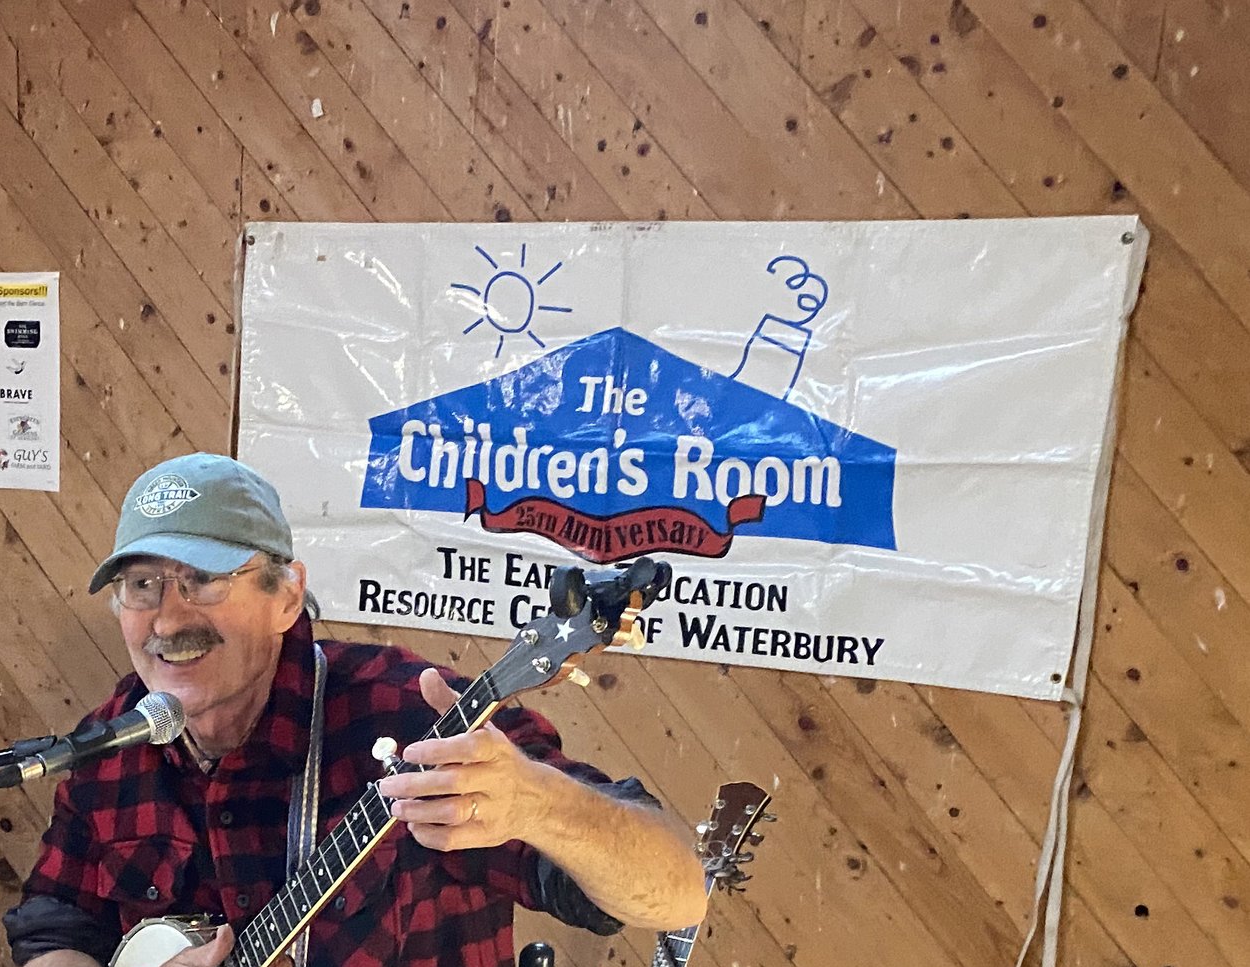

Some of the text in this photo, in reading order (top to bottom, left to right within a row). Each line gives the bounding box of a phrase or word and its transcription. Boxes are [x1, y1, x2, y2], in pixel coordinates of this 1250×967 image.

[0, 388, 33, 400] BRAVE
[575, 376, 648, 417] The
[13, 448, 49, 463] GUY'S
[399, 415, 842, 508] Children's Room
[135, 489, 192, 507] LONG TRAIL
[558, 513, 712, 552] Anniversary
[436, 546, 491, 584] THE
[638, 573, 788, 612] CATION
[358, 579, 496, 626] RESOURCE
[678, 611, 885, 666] WATERBURY
